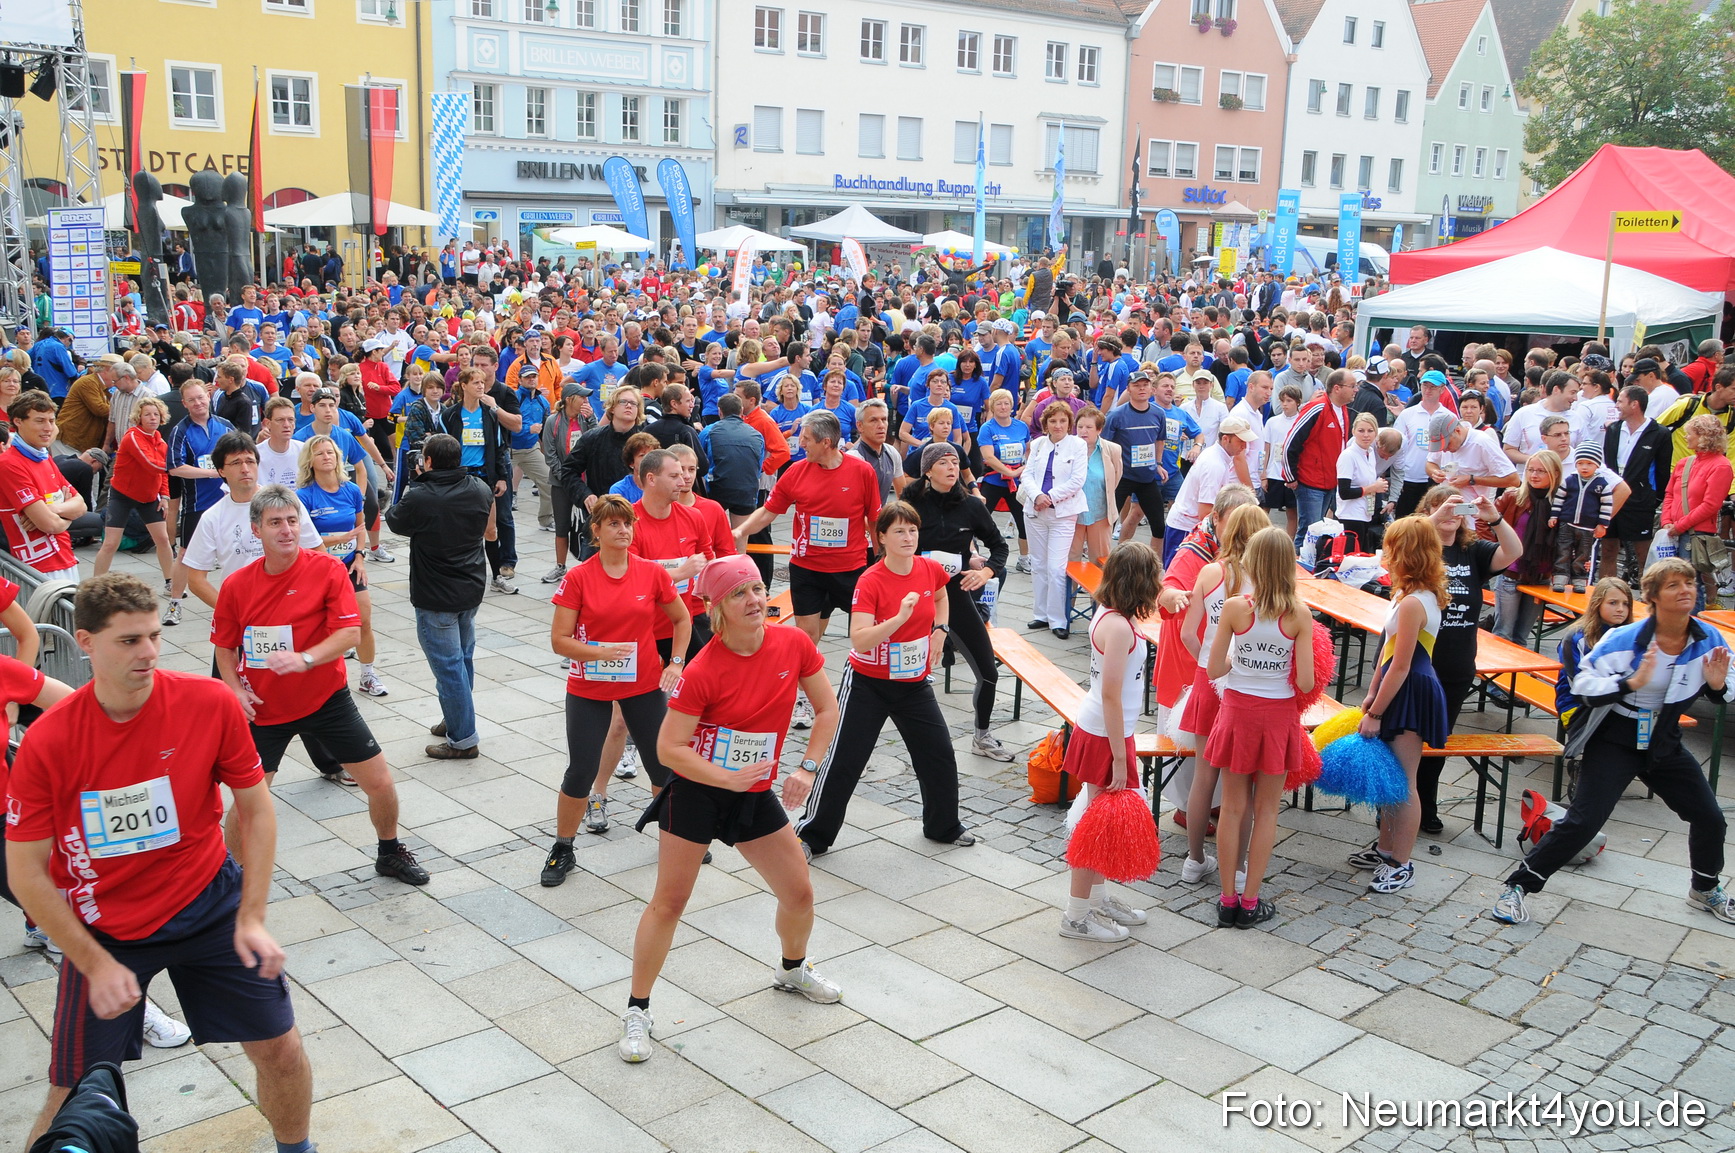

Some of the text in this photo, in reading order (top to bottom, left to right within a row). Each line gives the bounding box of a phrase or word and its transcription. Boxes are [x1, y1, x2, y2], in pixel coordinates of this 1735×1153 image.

[530, 46, 641, 71] BRILLEN WEBER
[98, 147, 250, 177] STDTCAFE
[516, 160, 585, 181] BRILLEN
[833, 174, 1002, 198] Buchhandlung Rupprcht
[1279, 199, 1295, 207] maxi
[61, 213, 92, 222] BOCK
[523, 212, 571, 221] BRILLEN WEBER
[1616, 217, 1669, 227] Toiletten
[1462, 225, 1482, 233] Musik
[1343, 230, 1355, 286] axi-dsl.de
[821, 528, 844, 537] 3289
[253, 630, 268, 638] Fritz
[255, 642, 287, 654] 3545
[1237, 642, 1290, 658] HS WEST
[601, 657, 631, 668] 3557
[904, 651, 926, 665] 3514
[1237, 656, 1288, 671] NEUMARKT
[734, 735, 768, 746] Gertraud
[732, 750, 768, 763] 3515
[104, 788, 149, 808] Michael
[110, 805, 168, 834] 2010
